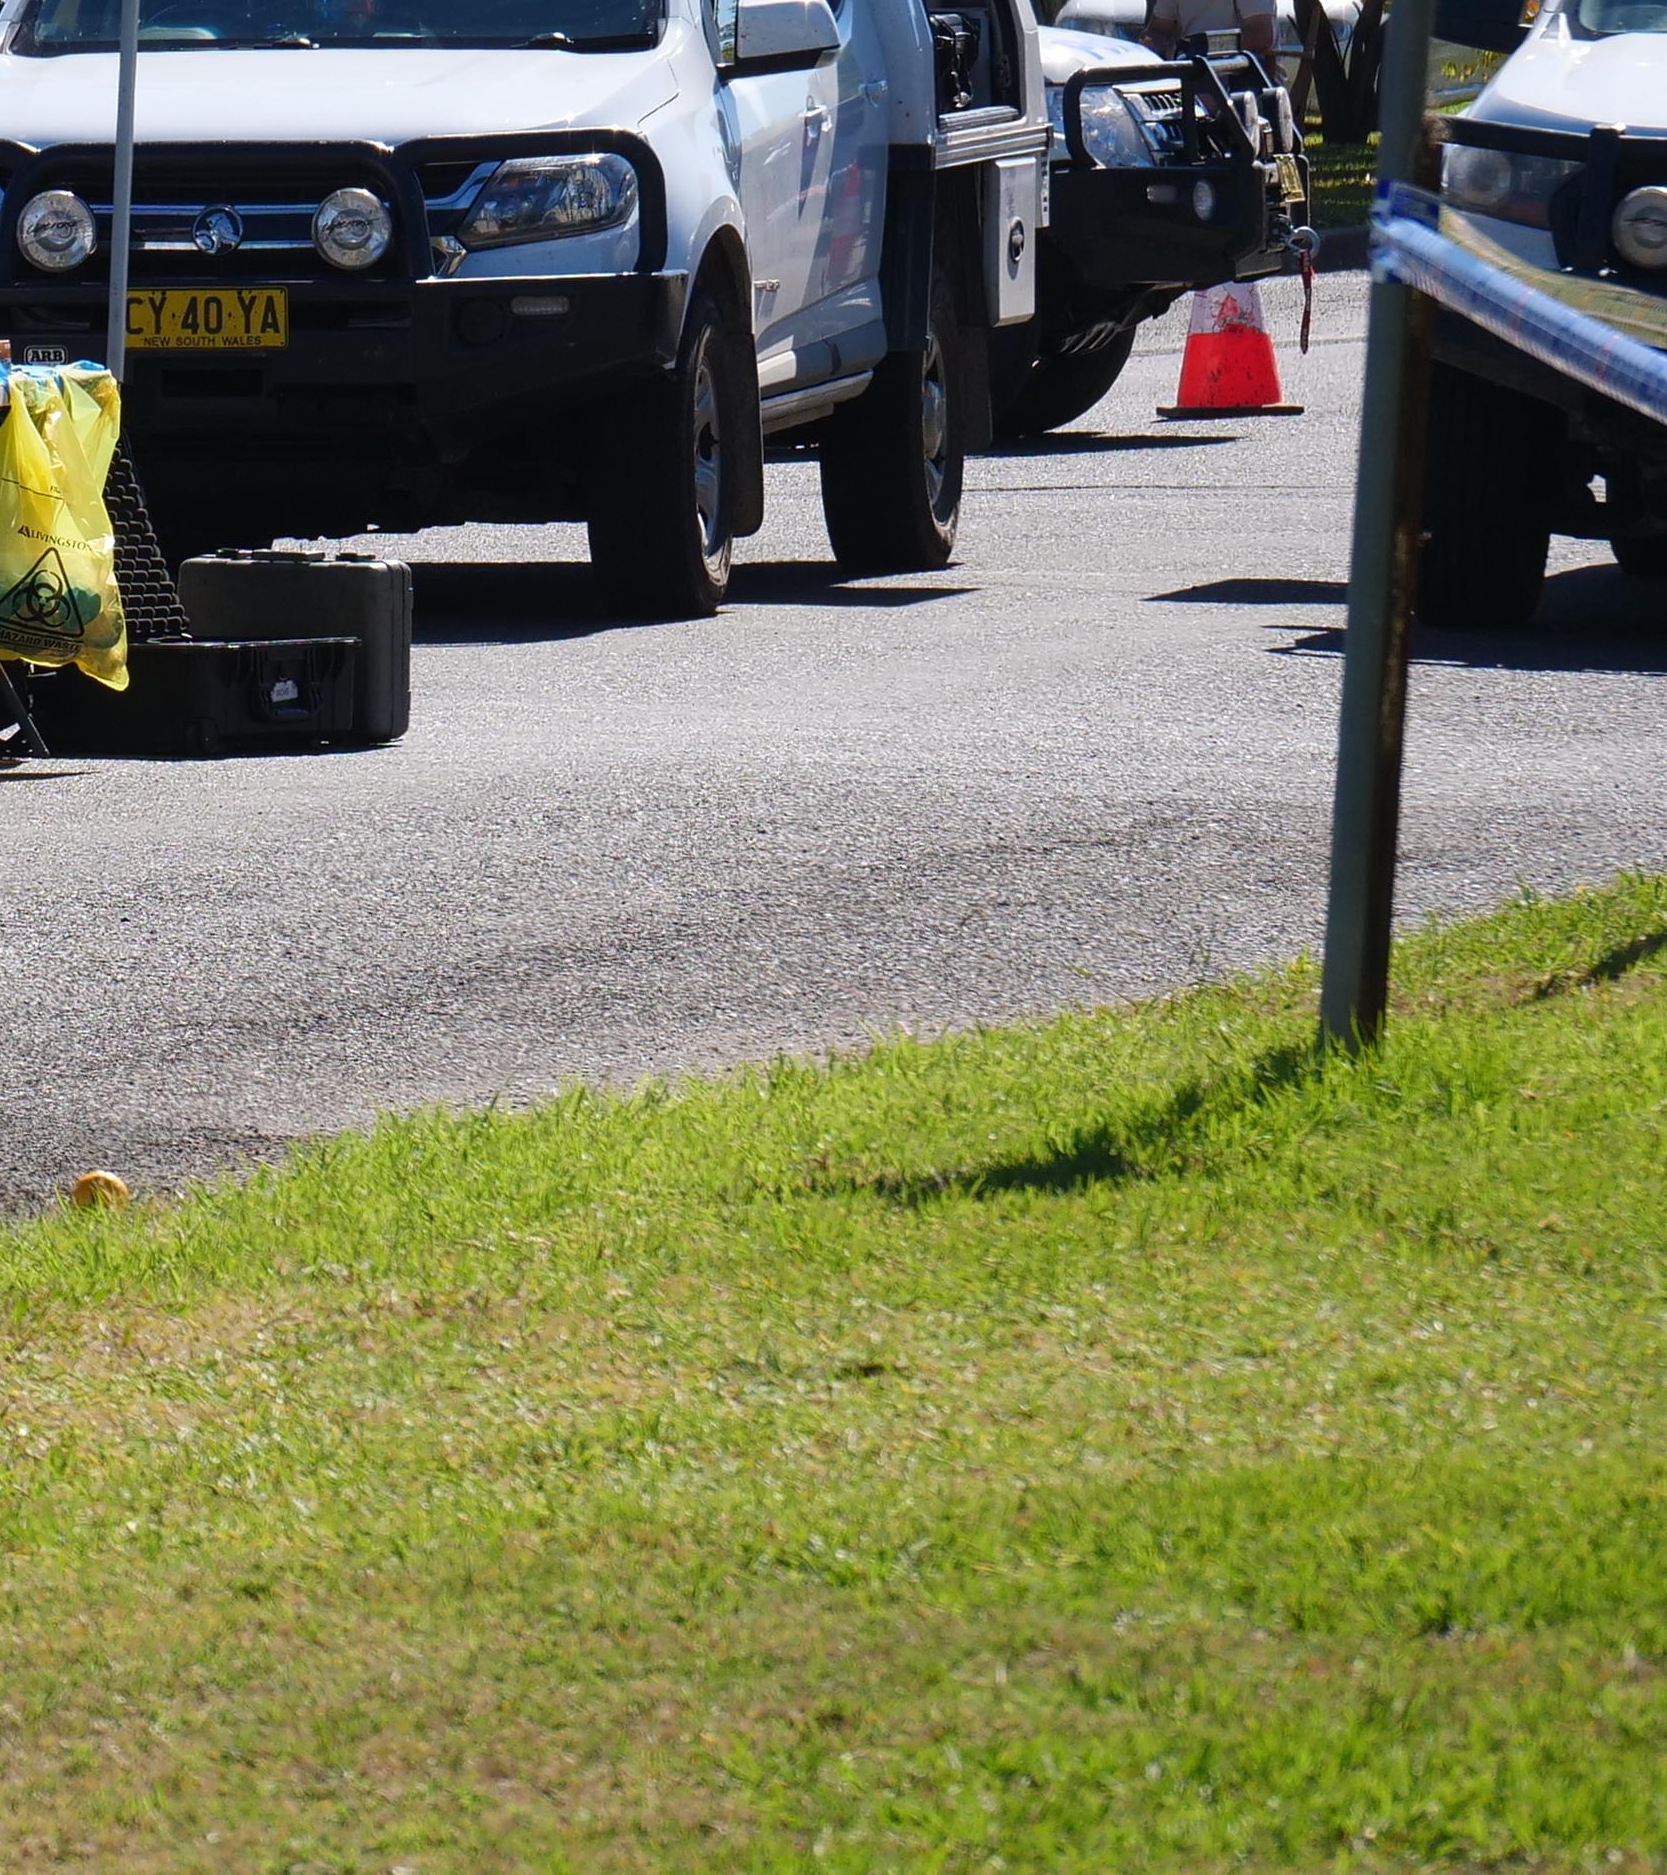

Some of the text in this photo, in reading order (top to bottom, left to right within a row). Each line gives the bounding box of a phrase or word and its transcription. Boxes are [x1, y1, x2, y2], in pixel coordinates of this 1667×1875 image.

[144, 335, 262, 347] NEW SOUTH WALES
[29, 349, 64, 363] ARB
